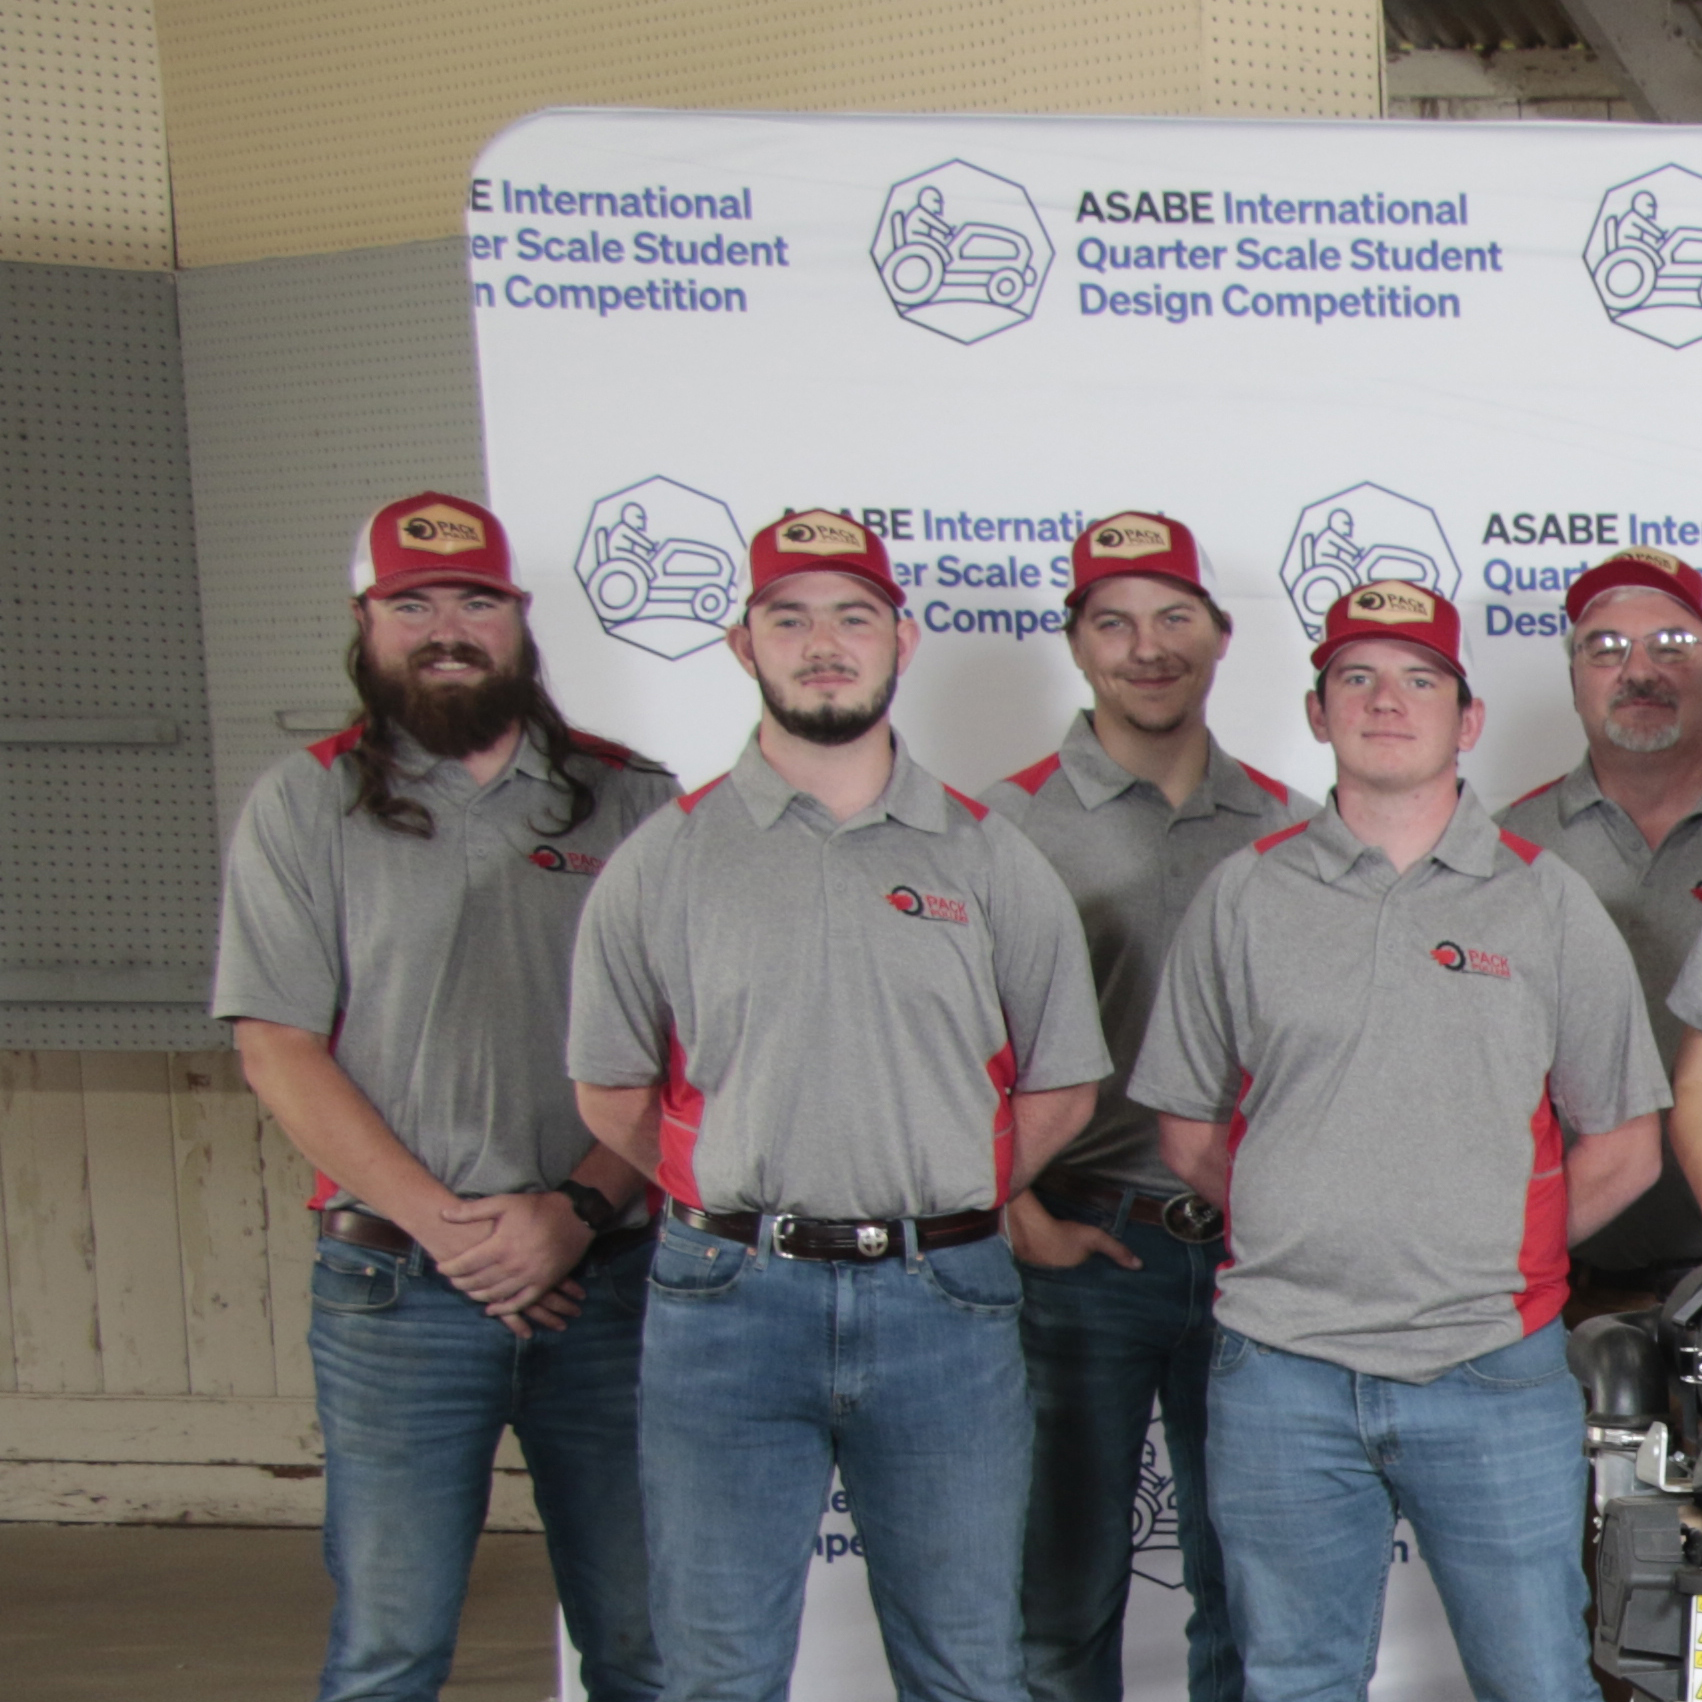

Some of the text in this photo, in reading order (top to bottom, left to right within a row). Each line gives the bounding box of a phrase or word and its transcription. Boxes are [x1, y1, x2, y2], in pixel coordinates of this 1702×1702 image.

[502, 180, 752, 220] International
[1076, 190, 1467, 225] ASABE International
[517, 227, 625, 264] Scale
[633, 231, 789, 267] Student
[1077, 237, 1502, 274] Quarter Scale Student
[505, 274, 747, 318] Competition
[1079, 283, 1460, 325] Design Competition
[815, 525, 856, 540] PACK
[1482, 513, 1619, 545] ASABE
[937, 555, 1041, 588] Scale
[1387, 593, 1424, 609] PACK
[1486, 605, 1567, 637] Desi
[924, 895, 965, 912] PACK
[1467, 950, 1508, 968] PACK
